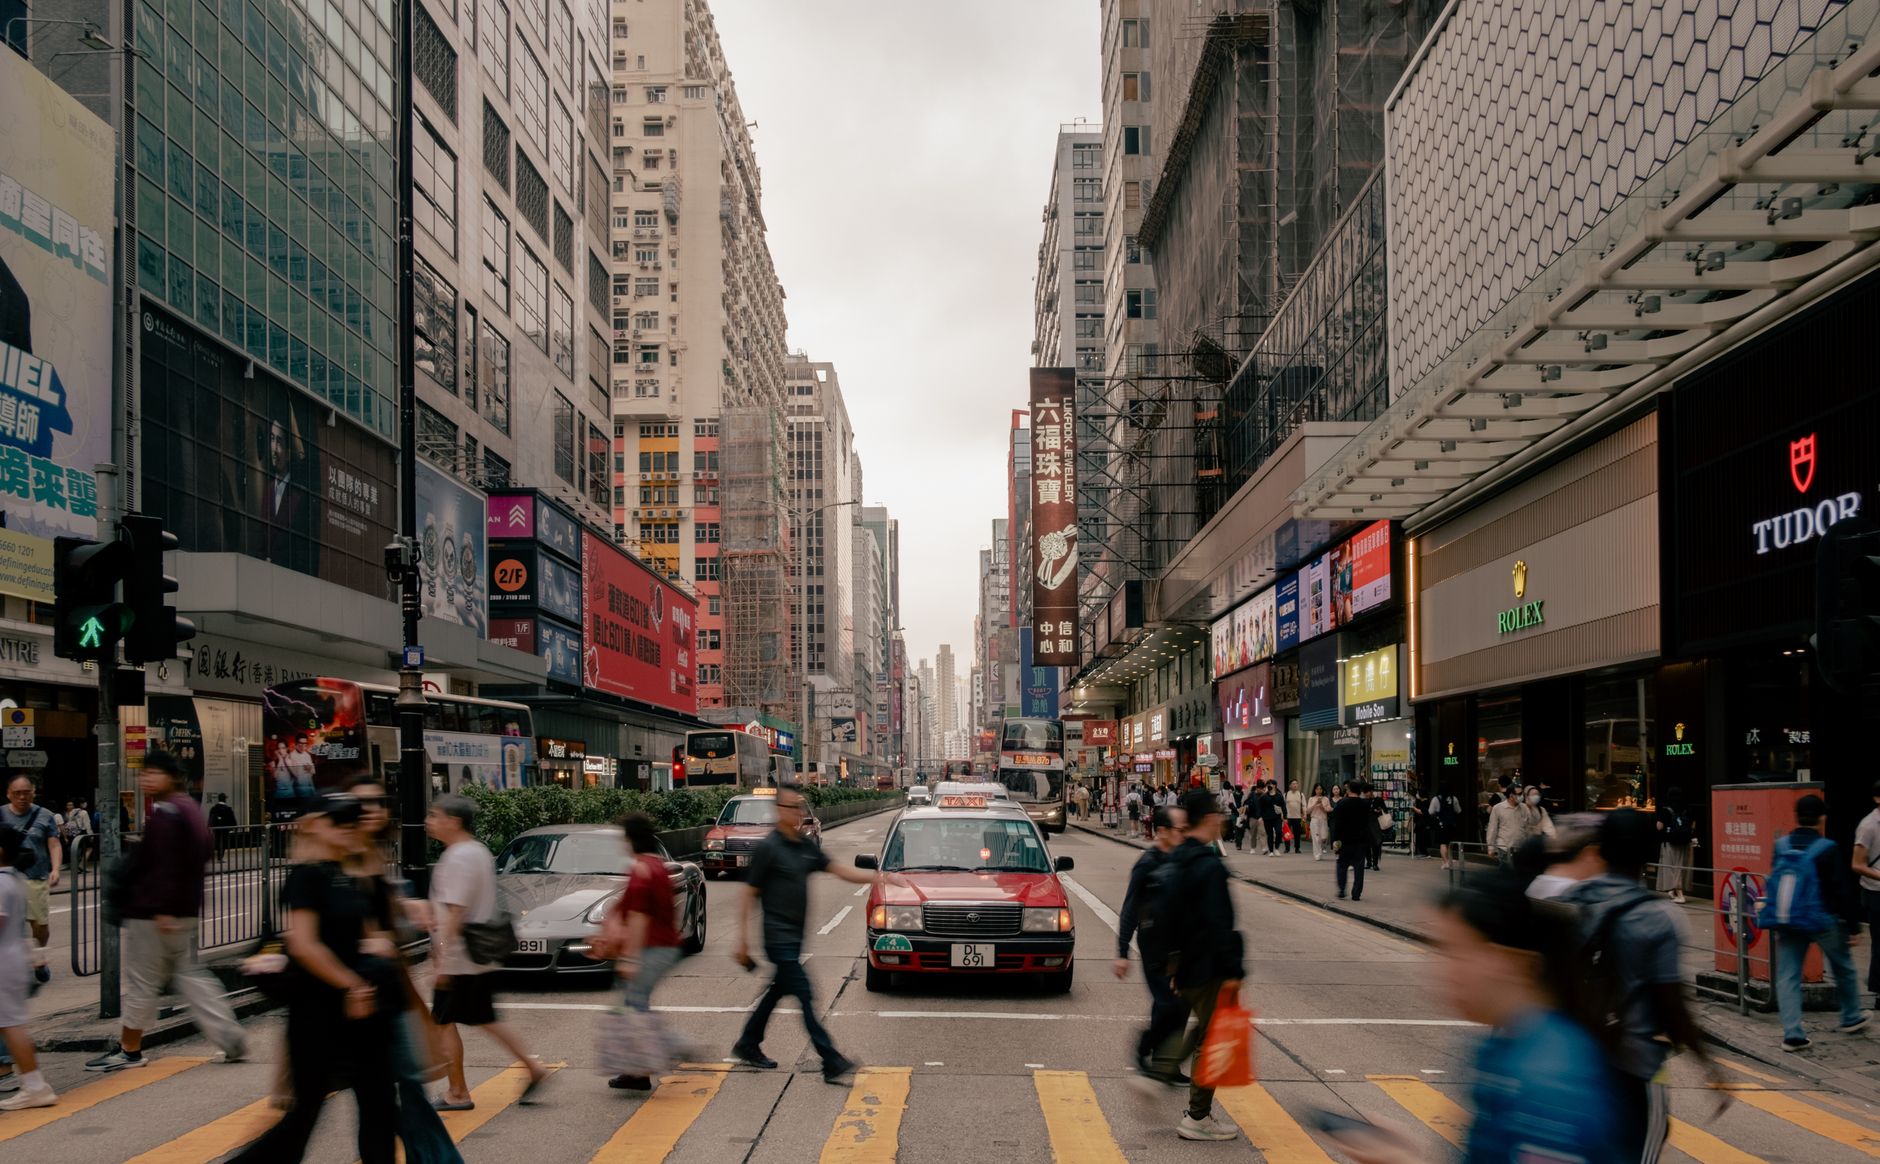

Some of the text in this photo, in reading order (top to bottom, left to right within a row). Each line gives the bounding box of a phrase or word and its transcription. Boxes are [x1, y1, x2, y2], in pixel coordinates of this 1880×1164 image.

[1036, 398, 1061, 504] 六福珠寶
[1063, 397, 1074, 504] LUKFOOK JEWELLERY
[1752, 491, 1862, 555] TUDOR
[18, 545, 34, 557] 1201
[499, 568, 523, 583] 2/F
[1498, 601, 1543, 633] ROLEX
[516, 623, 528, 633] 1/F
[1355, 705, 1372, 720] Mobile
[23, 739, 33, 747] 12
[1666, 743, 1693, 756] ROLEX
[945, 796, 984, 806] TAXI
[520, 940, 543, 951] 891
[964, 945, 982, 955] DL
[962, 955, 984, 966] 691
